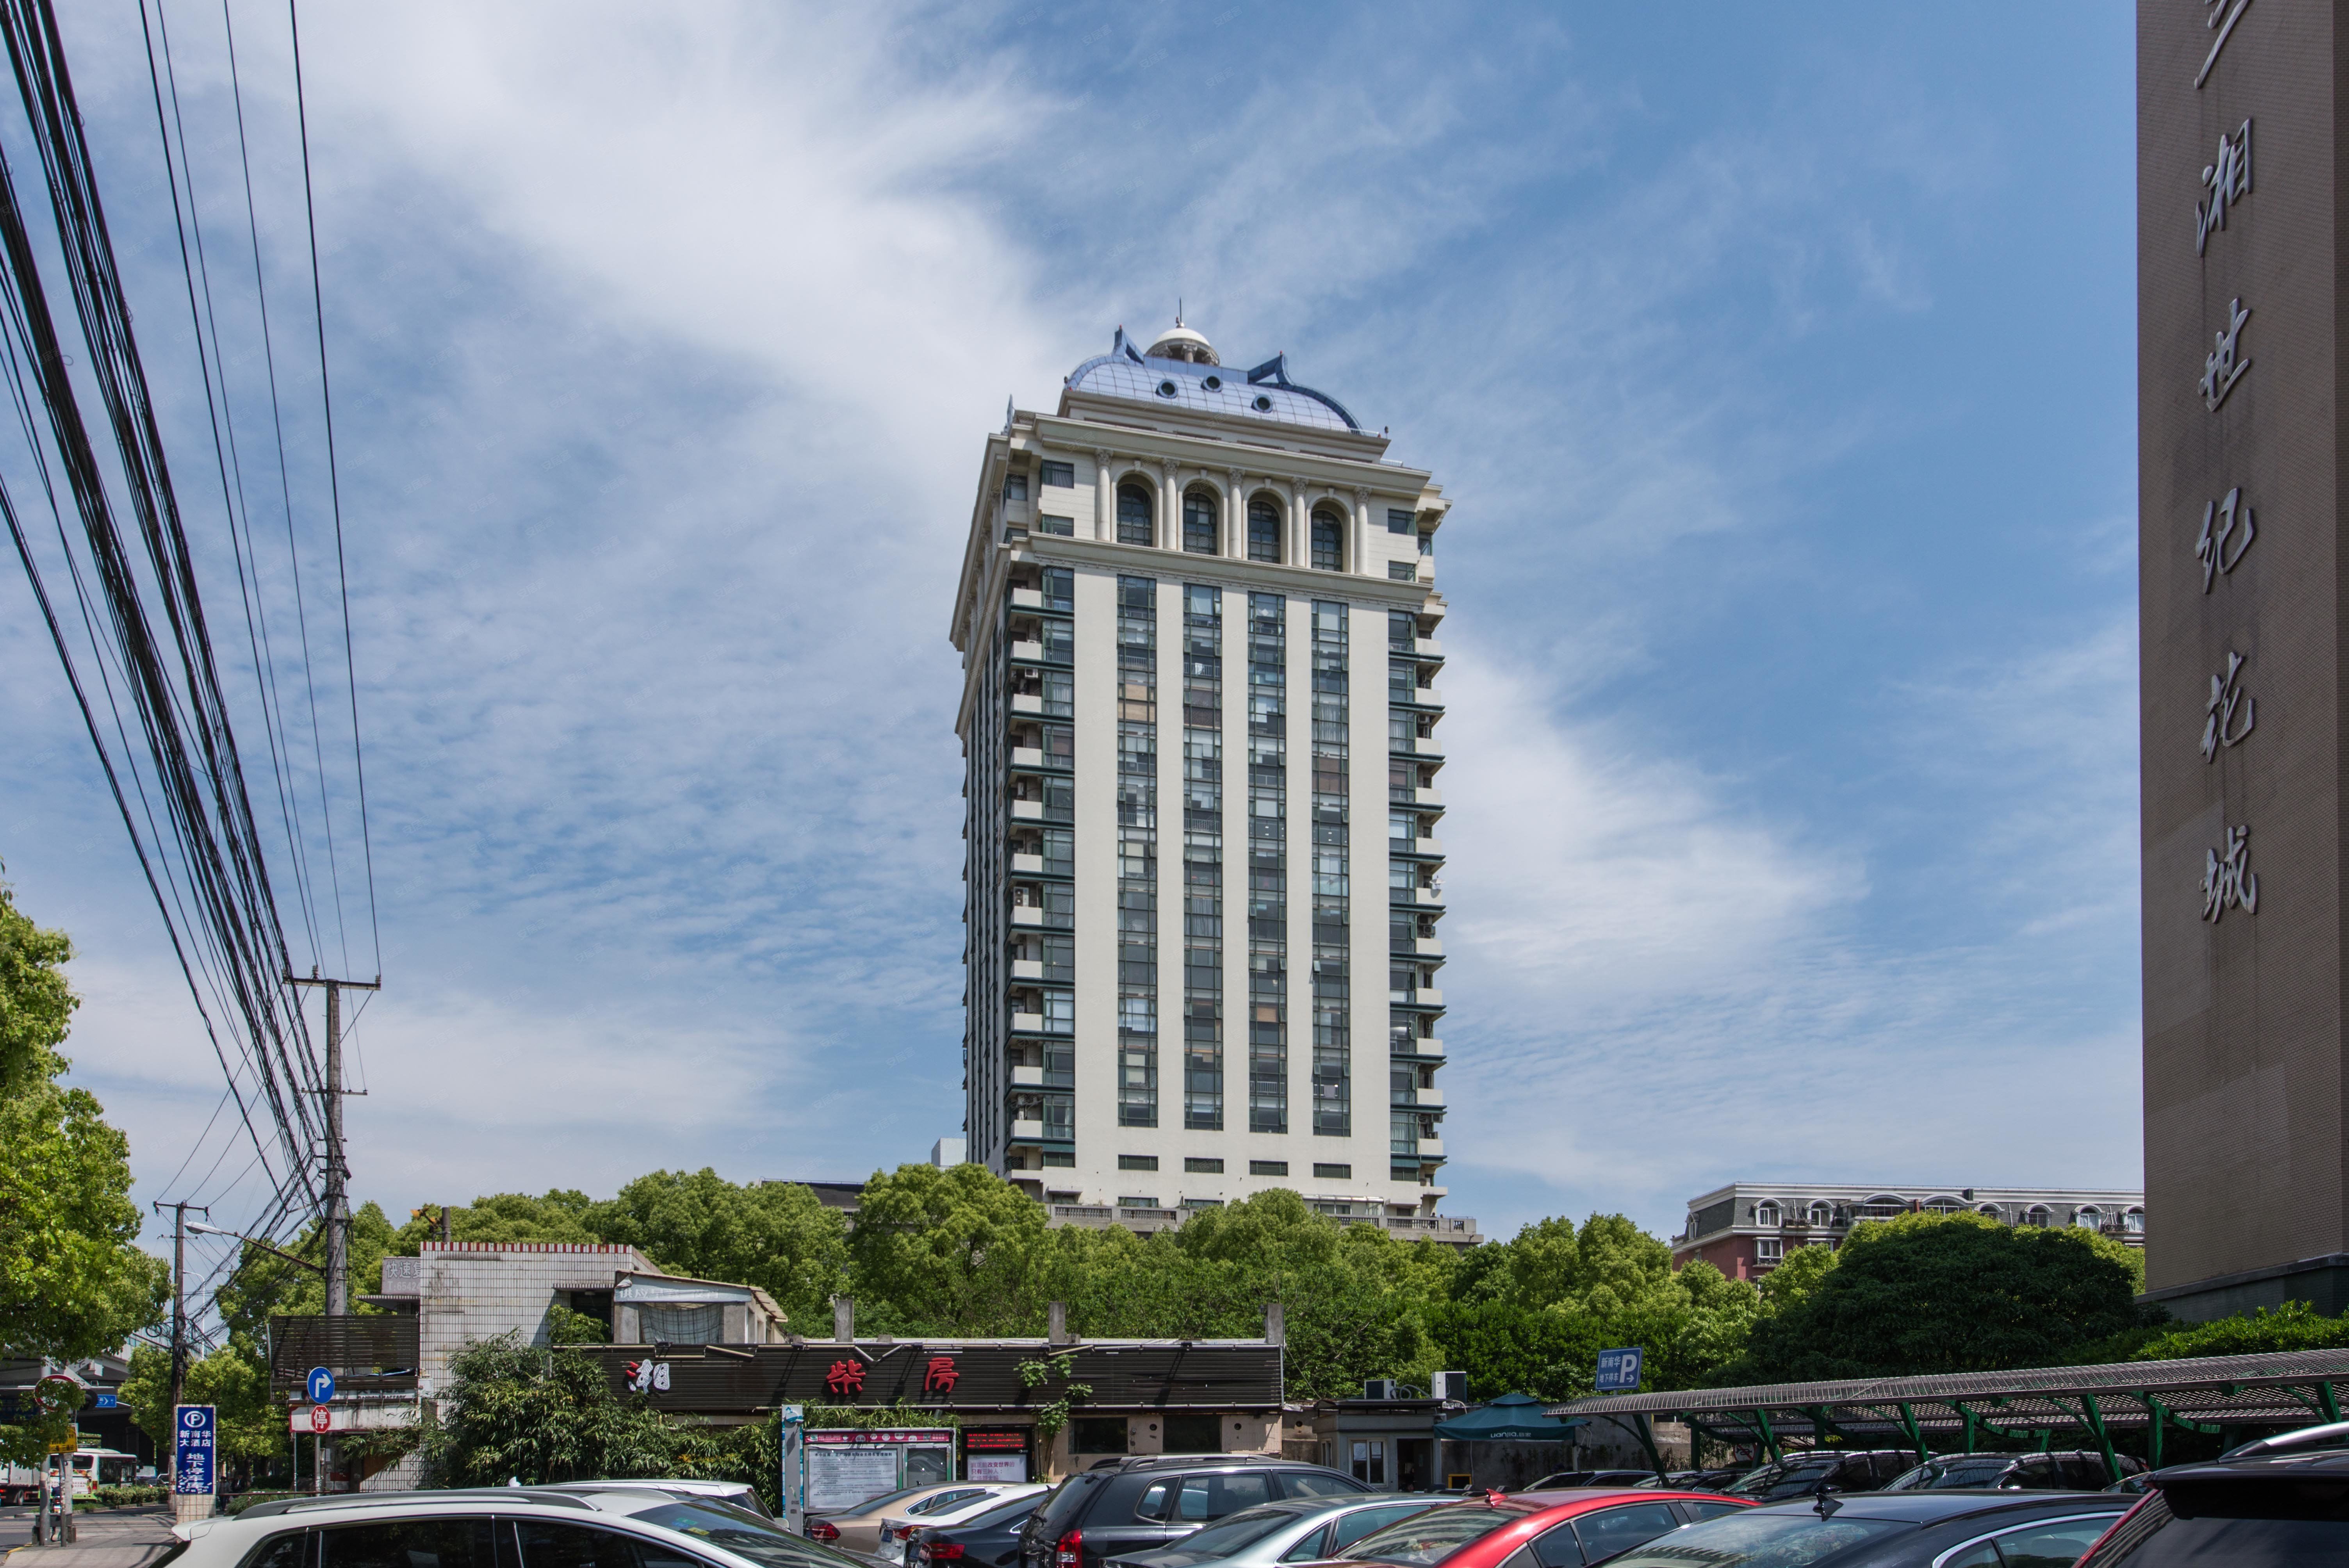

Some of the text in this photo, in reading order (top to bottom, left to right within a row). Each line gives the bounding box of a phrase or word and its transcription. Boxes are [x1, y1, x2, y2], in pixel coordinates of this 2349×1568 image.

[1601, 1355, 1621, 1368] 新南华
[1619, 1354, 1637, 1383] P
[1599, 1372, 1619, 1383] 地下停车
[314, 1409, 328, 1429] 停
[180, 1430, 212, 1438] 新南华
[180, 1439, 211, 1447] 大酒店
[185, 1453, 205, 1489] 地下停车库
